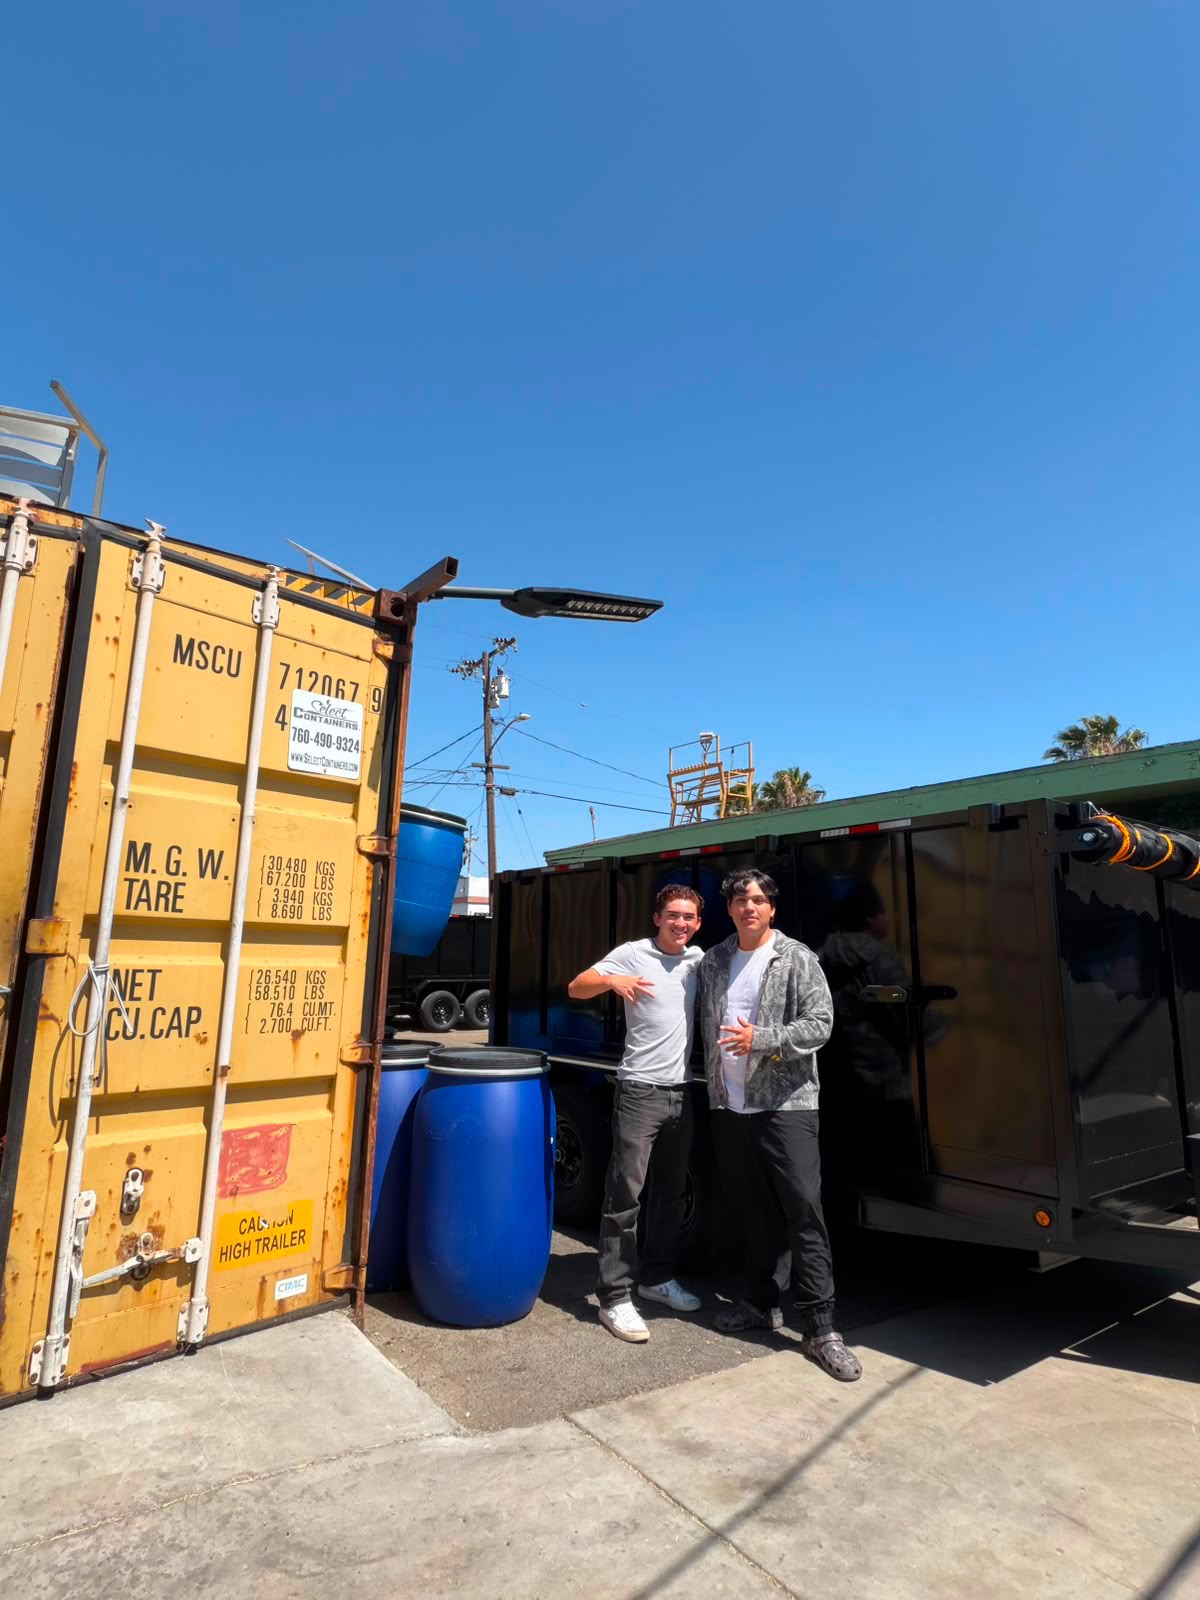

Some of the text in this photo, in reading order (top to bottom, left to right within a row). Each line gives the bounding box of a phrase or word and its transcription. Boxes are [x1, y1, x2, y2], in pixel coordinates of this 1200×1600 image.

[172, 633, 382, 713] MSCU 712067 9
[310, 700, 355, 720] Select
[292, 726, 360, 754] 760-490-9324
[316, 861, 336, 876] KGS
[314, 876, 334, 890] LBS
[124, 878, 186, 914] TARE
[312, 892, 333, 906] KGS
[312, 906, 332, 921] LBS
[109, 968, 162, 1002] NET
[306, 970, 326, 984] KGS
[304, 985, 325, 1000] LBS
[270, 1002, 293, 1018] 76.4
[238, 1209, 294, 1236] CAUN
[218, 1229, 306, 1264] HIGH TRAILER
[277, 1278, 304, 1293] CIMC
